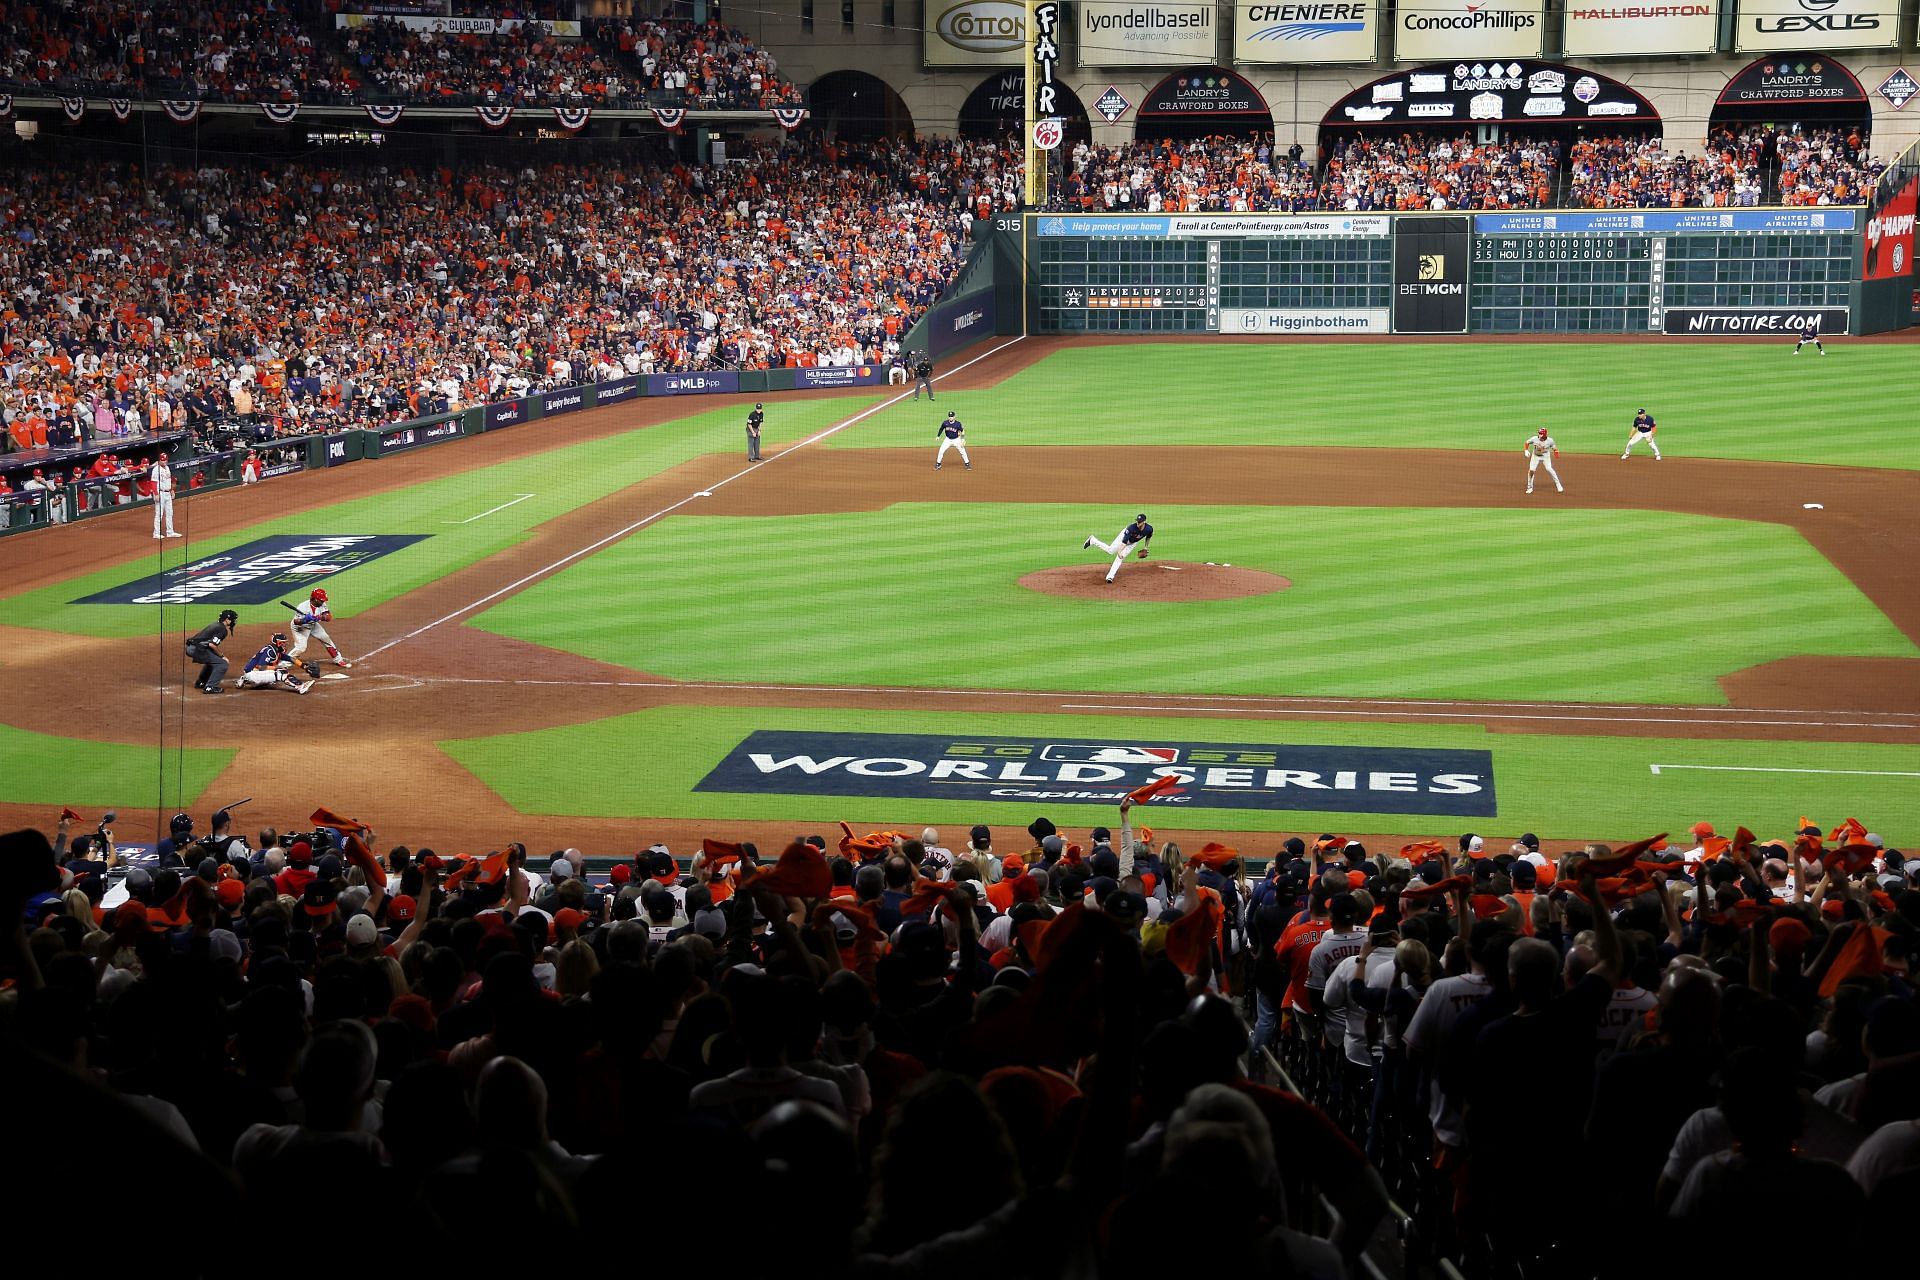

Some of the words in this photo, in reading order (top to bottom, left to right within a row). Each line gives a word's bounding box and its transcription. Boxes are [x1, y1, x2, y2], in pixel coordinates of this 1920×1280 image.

[1249, 3, 1366, 22] CHENIERE
[1573, 5, 1711, 21] HALLIBURTON
[449, 20, 471, 31] CLUB
[473, 20, 491, 31] BAR
[951, 12, 1026, 40] COTTON
[1086, 8, 1210, 32] lyondellbasell
[1404, 11, 1536, 32] ConocoPhillips
[1755, 15, 1881, 34] LEXUS
[1123, 32, 1170, 41] Advancing
[1174, 31, 1210, 41] Possible
[1036, 6, 1057, 113] FAIR
[1454, 78, 1521, 90] LANDRY'S
[1762, 75, 1822, 85] LANDRY'S
[1177, 89, 1230, 97] LANDRY'S
[1740, 89, 1804, 99] CRAWFORD
[1808, 88, 1844, 97] BOXES
[1158, 102, 1214, 110] CRAWFORD
[1218, 101, 1249, 110] BOXES
[996, 219, 1021, 231] 315
[1072, 222, 1090, 231] Help
[1092, 222, 1121, 232] protect
[1121, 224, 1138, 232] your
[1139, 222, 1162, 231] home
[1176, 221, 1199, 230] Enroll
[1201, 222, 1209, 230] at
[1210, 220, 1330, 232] CenterPointEnergy.com/Astros
[1476, 240, 1482, 249] 5
[1486, 240, 1492, 249] 2
[1502, 240, 1517, 249] PHI
[1527, 240, 1533, 248] 0
[1538, 240, 1544, 248] 0
[1549, 240, 1555, 248] 0
[1561, 240, 1567, 248] 0
[1573, 240, 1579, 248] 0
[1584, 240, 1590, 248] 0
[1596, 239, 1601, 248] 1
[1607, 239, 1613, 248] 0
[1644, 239, 1648, 247] 1
[1475, 251, 1481, 259] 5
[1486, 251, 1492, 259] 5
[1499, 250, 1519, 259] HOU
[1527, 251, 1532, 259] 3
[1538, 251, 1544, 259] 0
[1549, 251, 1555, 259] 0
[1572, 250, 1578, 258] 2
[1584, 250, 1589, 258] 0
[1595, 250, 1601, 258] 0
[1607, 250, 1613, 258] 0
[1643, 249, 1649, 258] 5
[1209, 244, 1218, 326] NATIONAL
[1400, 284, 1462, 295] BETMGM
[1651, 242, 1663, 326] AMERICAN
[1269, 315, 1369, 330] Higginbotham
[1688, 311, 1822, 333] NITTOTIRE.COM
[680, 377, 705, 389] MLB
[705, 378, 720, 388] App
[329, 440, 345, 458] FOX
[747, 753, 1126, 783] WORLD
[1145, 765, 1483, 795] SERIES
[989, 788, 1129, 800] Capital
